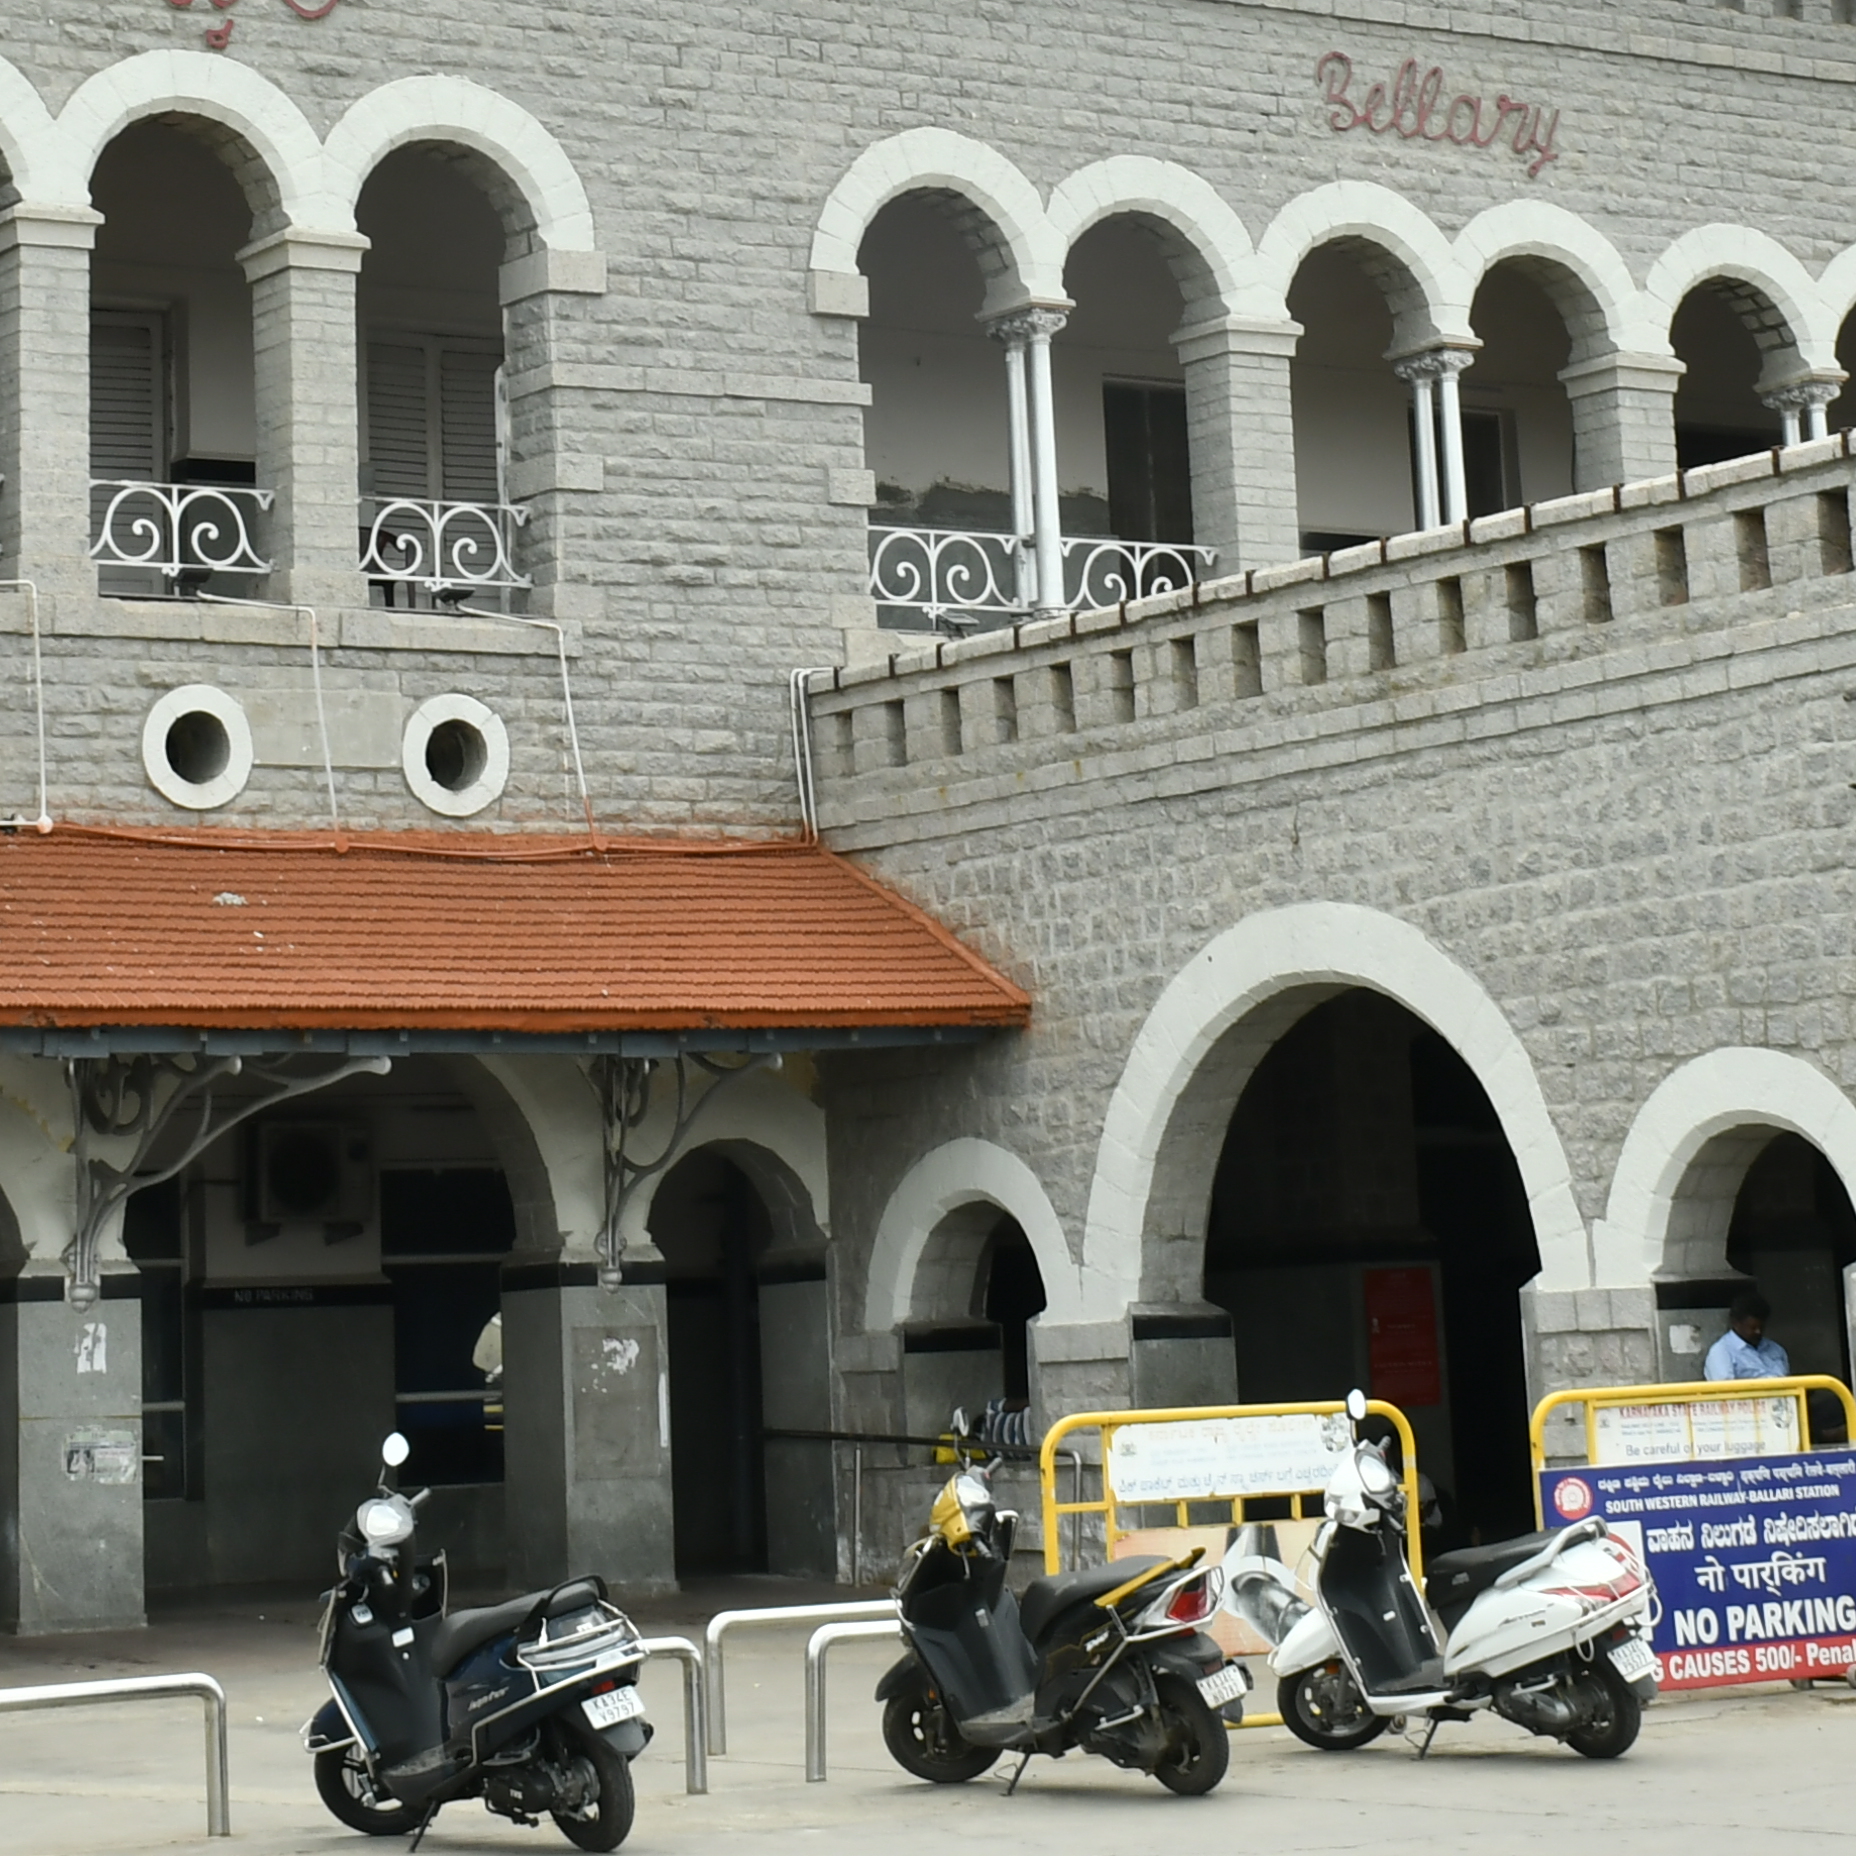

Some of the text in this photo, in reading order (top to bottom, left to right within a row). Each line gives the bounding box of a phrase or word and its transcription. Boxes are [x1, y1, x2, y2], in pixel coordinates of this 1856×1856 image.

[1317, 50, 1560, 179] Bellary
[1625, 1444, 1641, 1457] Be
[1643, 1442, 1680, 1456] careful
[1697, 1442, 1721, 1457] your
[1605, 1483, 1841, 1515] SOUTH WESTERN RAILWAY-BALLARI STATION
[1646, 1517, 1695, 1553] ವಾಹನ
[1694, 1554, 1726, 1593] नो
[1673, 1606, 1720, 1646] NO
[1669, 1649, 1750, 1680] CAUSES
[1755, 1643, 1803, 1673] 500/-
[592, 1688, 632, 1710] KA34E
[599, 1701, 635, 1722] V9797
